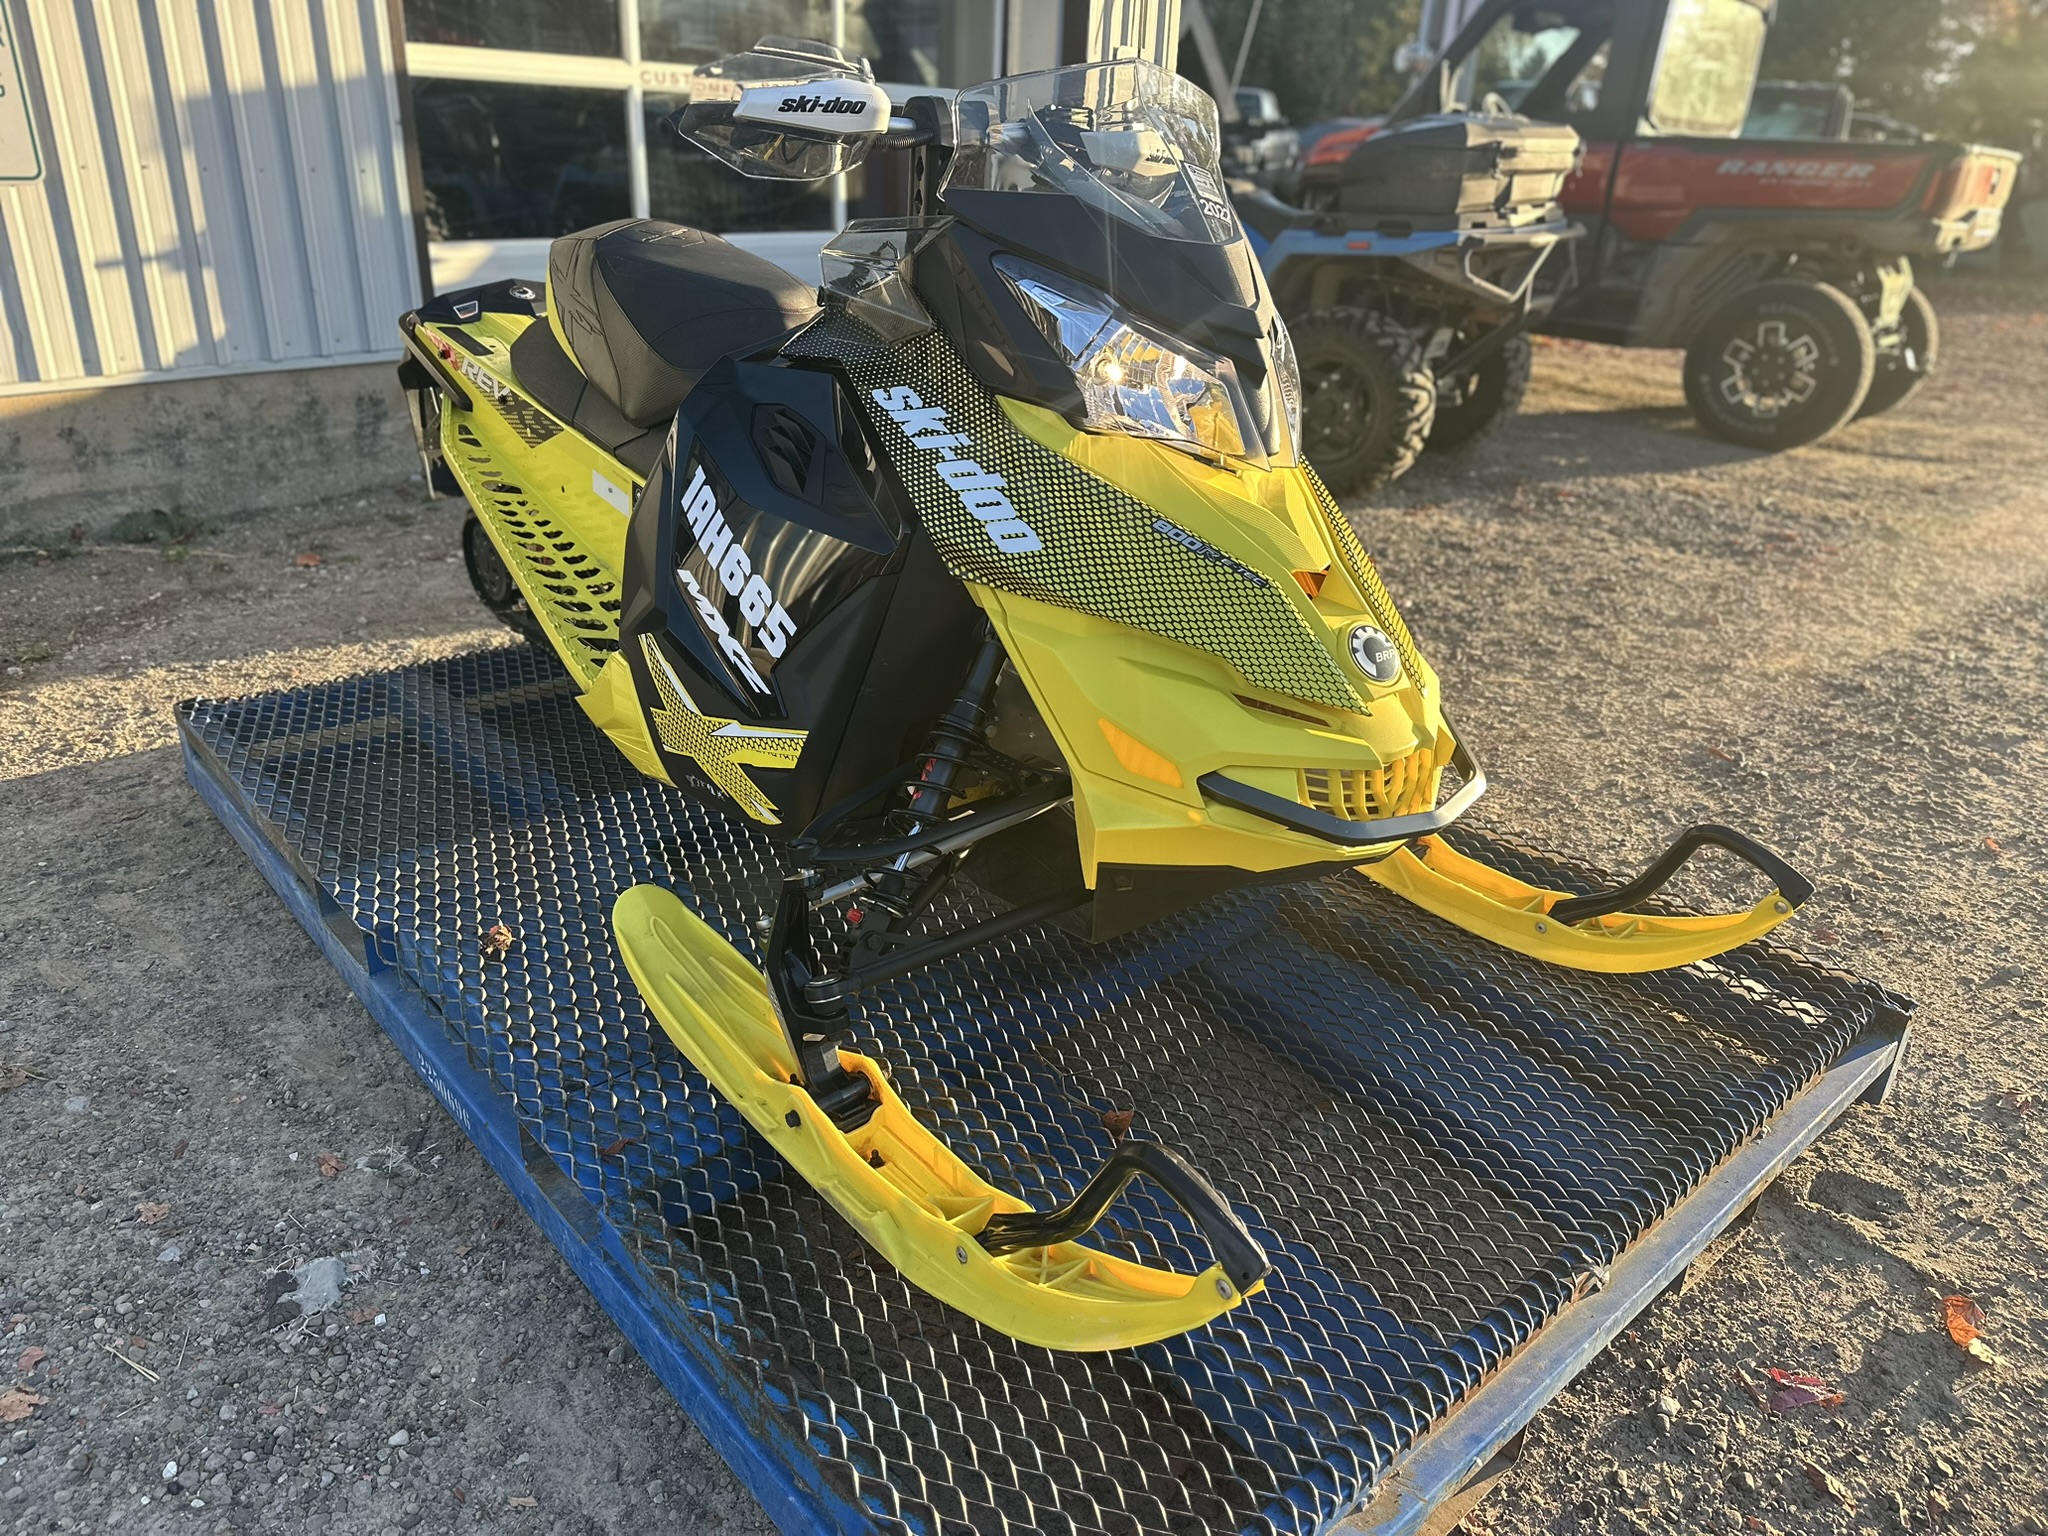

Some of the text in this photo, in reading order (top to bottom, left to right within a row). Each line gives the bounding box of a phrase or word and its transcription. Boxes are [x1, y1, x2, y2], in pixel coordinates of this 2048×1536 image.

[778, 96, 867, 115] ski-doo
[1716, 159, 1876, 179] RANGER
[461, 356, 511, 401] REV
[871, 385, 1043, 554] ski-doo
[681, 464, 798, 659] 1AH665
[1152, 519, 1221, 563] 800R
[1375, 648, 1395, 663] BRP
